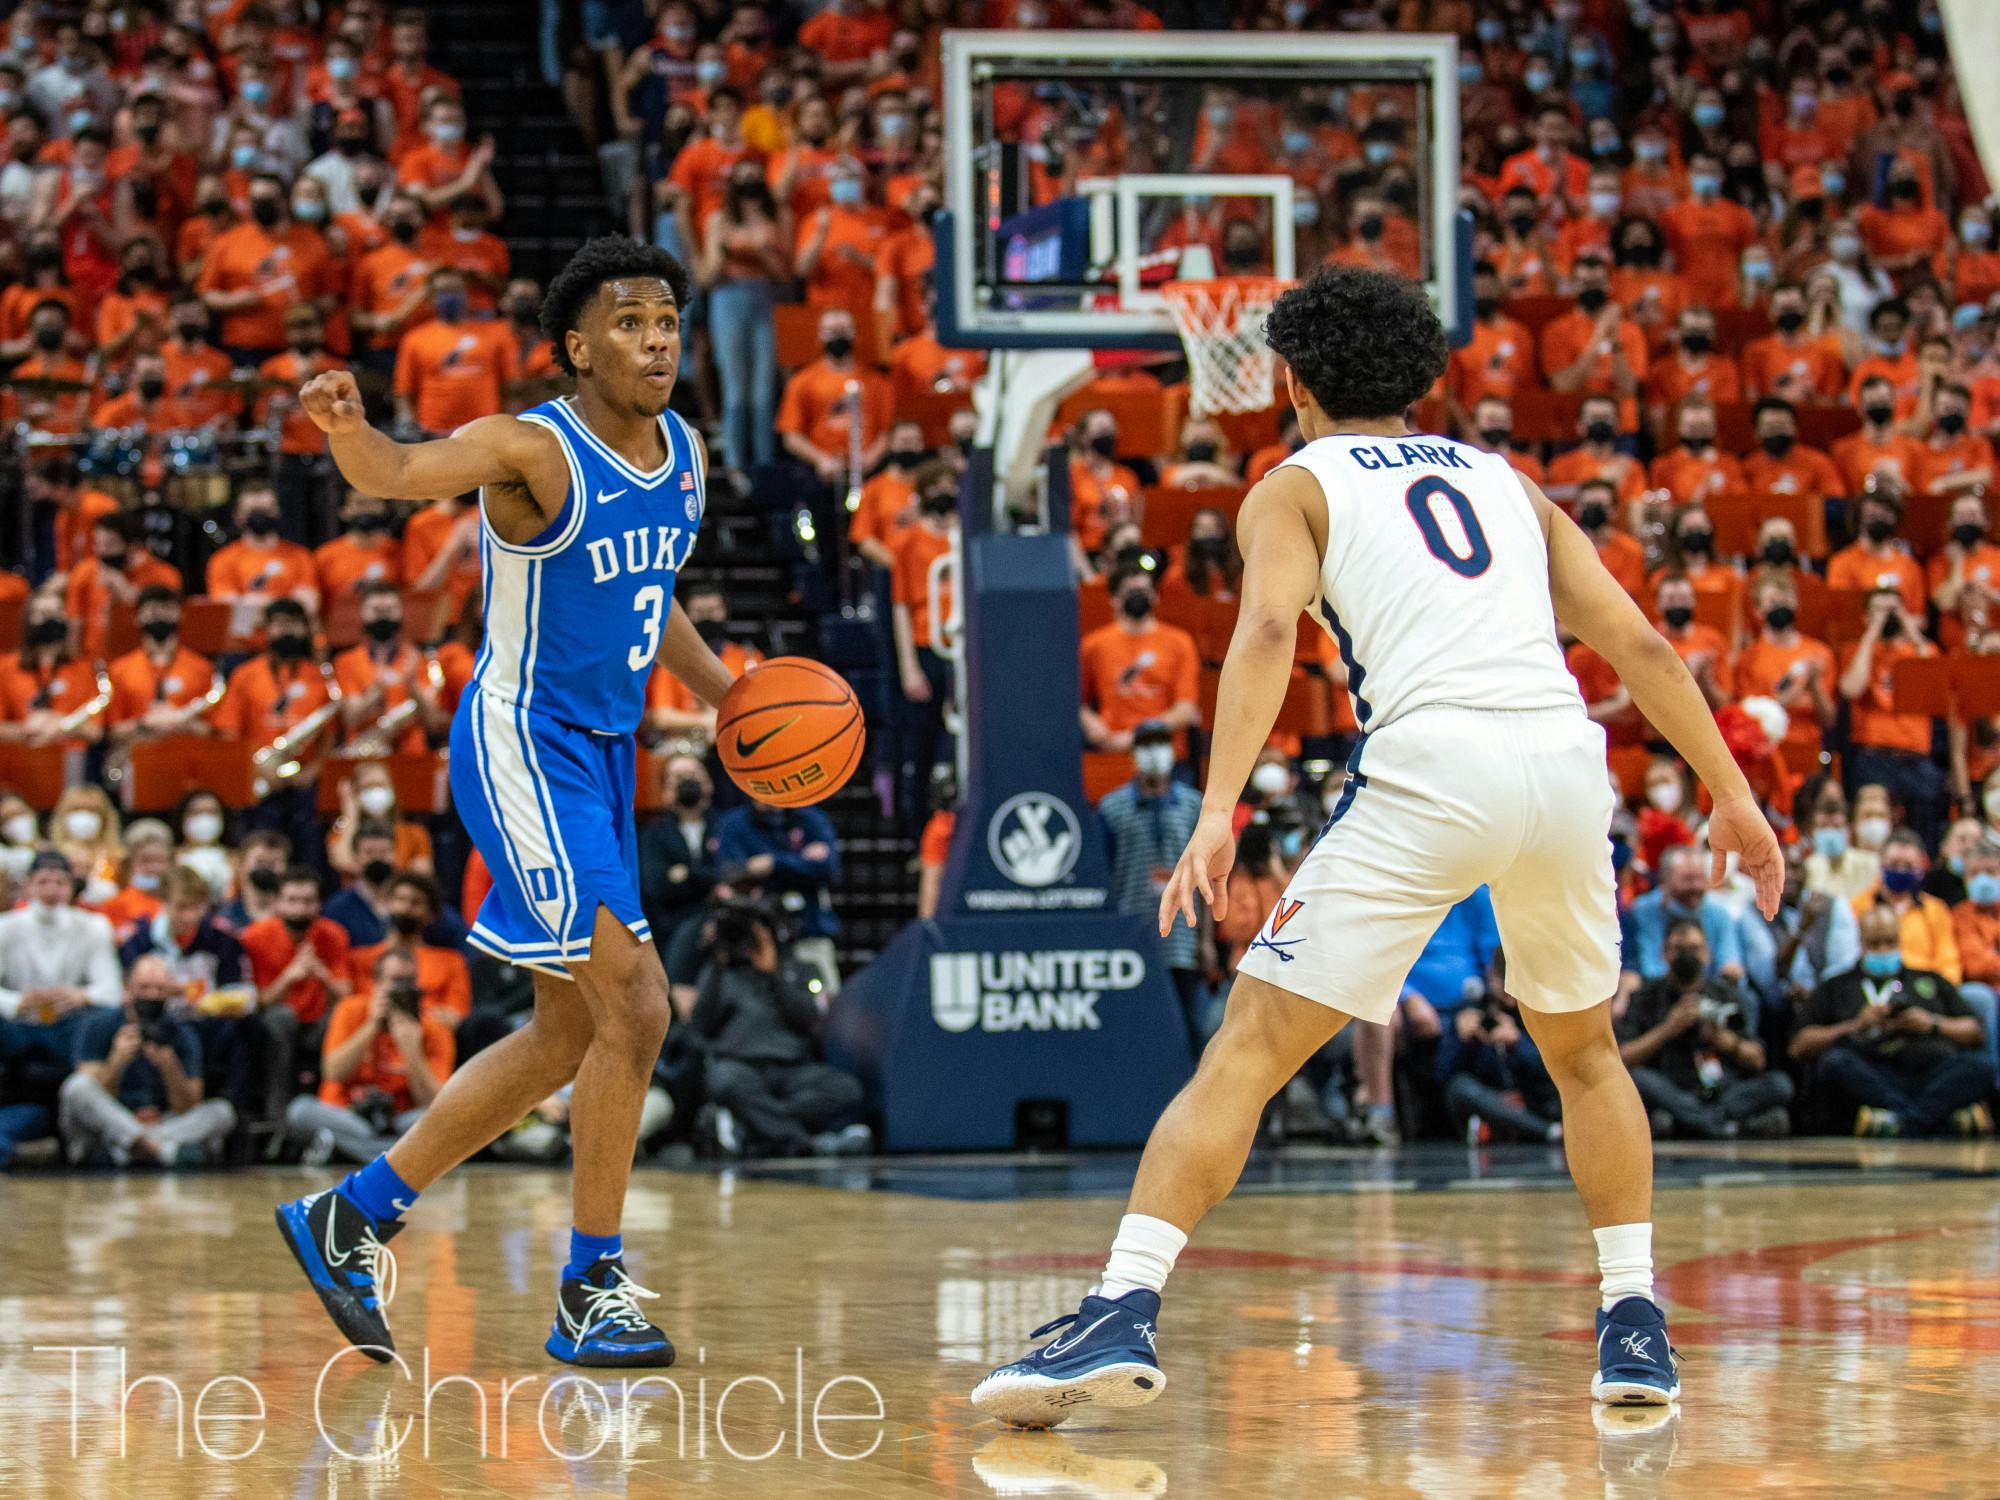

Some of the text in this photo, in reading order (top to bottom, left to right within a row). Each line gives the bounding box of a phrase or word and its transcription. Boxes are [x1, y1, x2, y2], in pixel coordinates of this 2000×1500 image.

[1349, 443, 1473, 470] CLARK
[1405, 475, 1493, 579] 0
[627, 585, 664, 672] 3
[750, 762, 825, 795] ELITE
[981, 949, 1146, 990] UNITED
[981, 991, 1101, 1032] BANK
